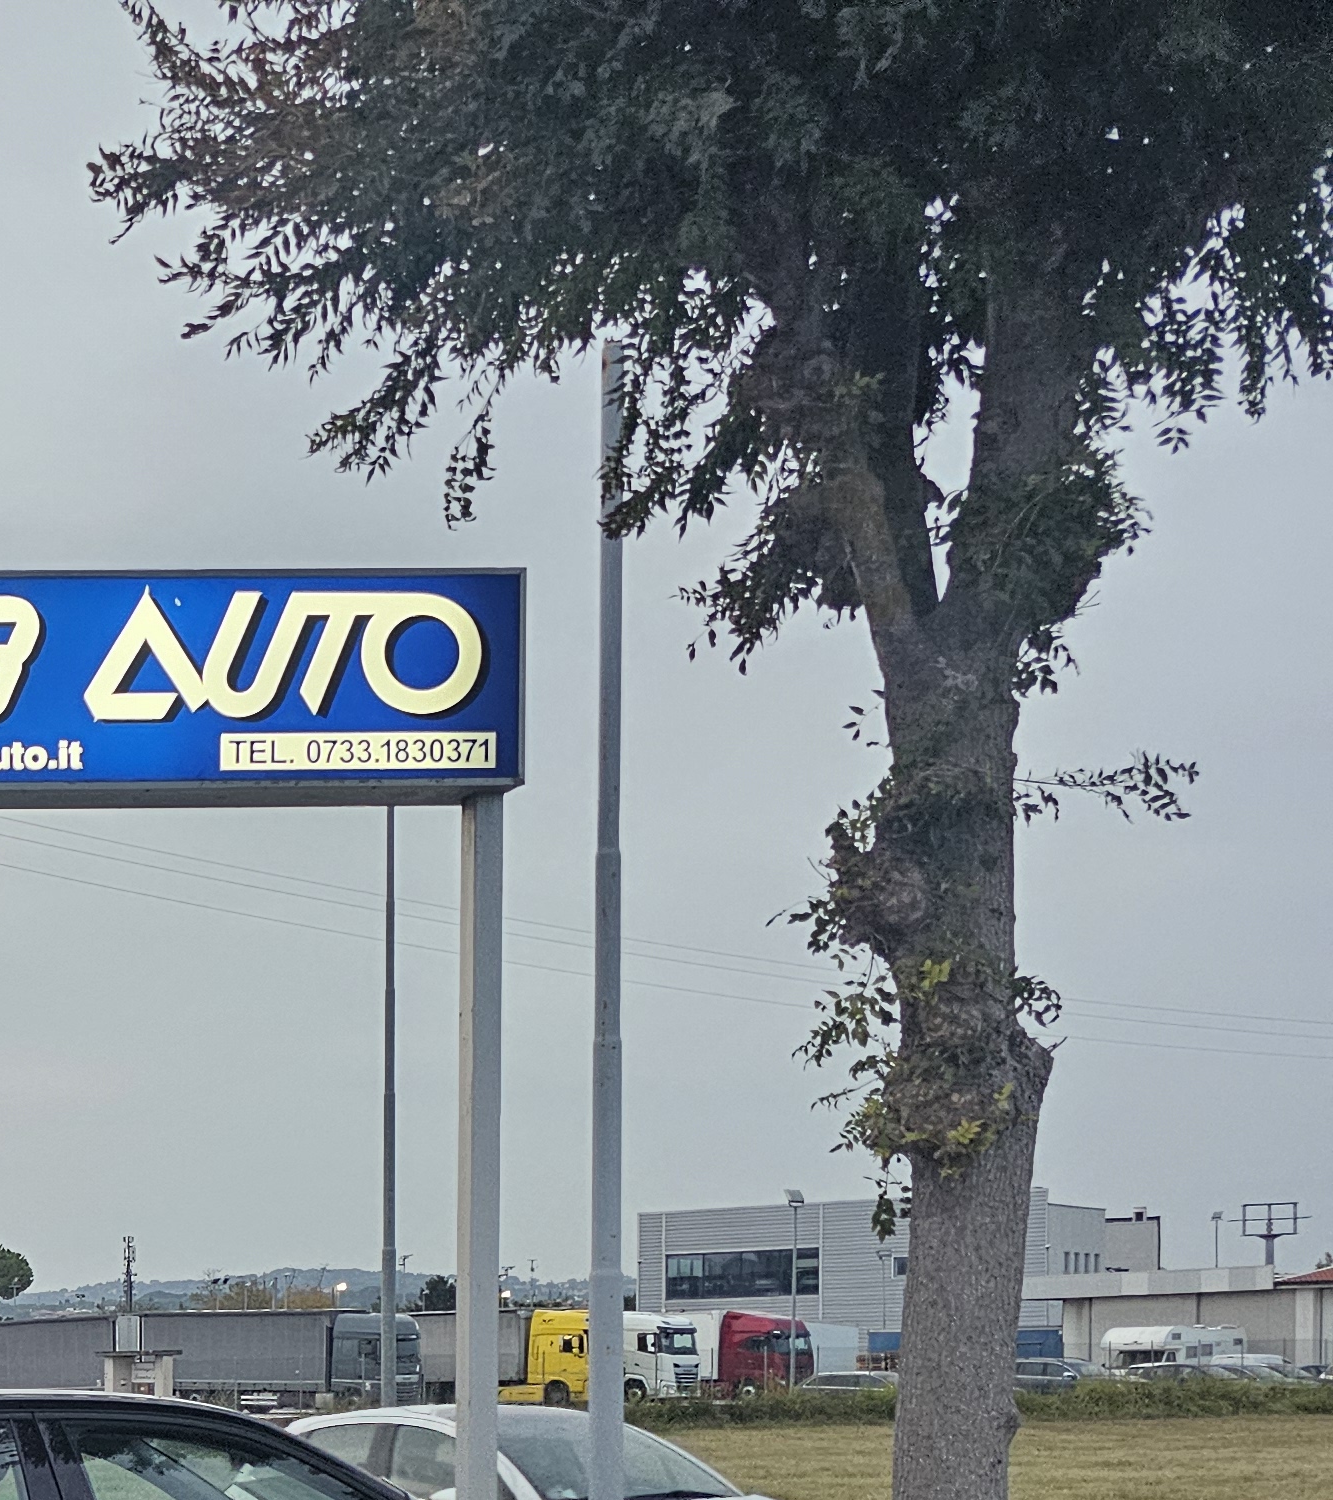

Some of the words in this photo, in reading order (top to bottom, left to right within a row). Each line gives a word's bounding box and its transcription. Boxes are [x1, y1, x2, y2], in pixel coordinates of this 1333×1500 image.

[84, 586, 485, 722] AUTO
[229, 740, 295, 764] TEL.
[306, 738, 490, 764] 0733.1830371
